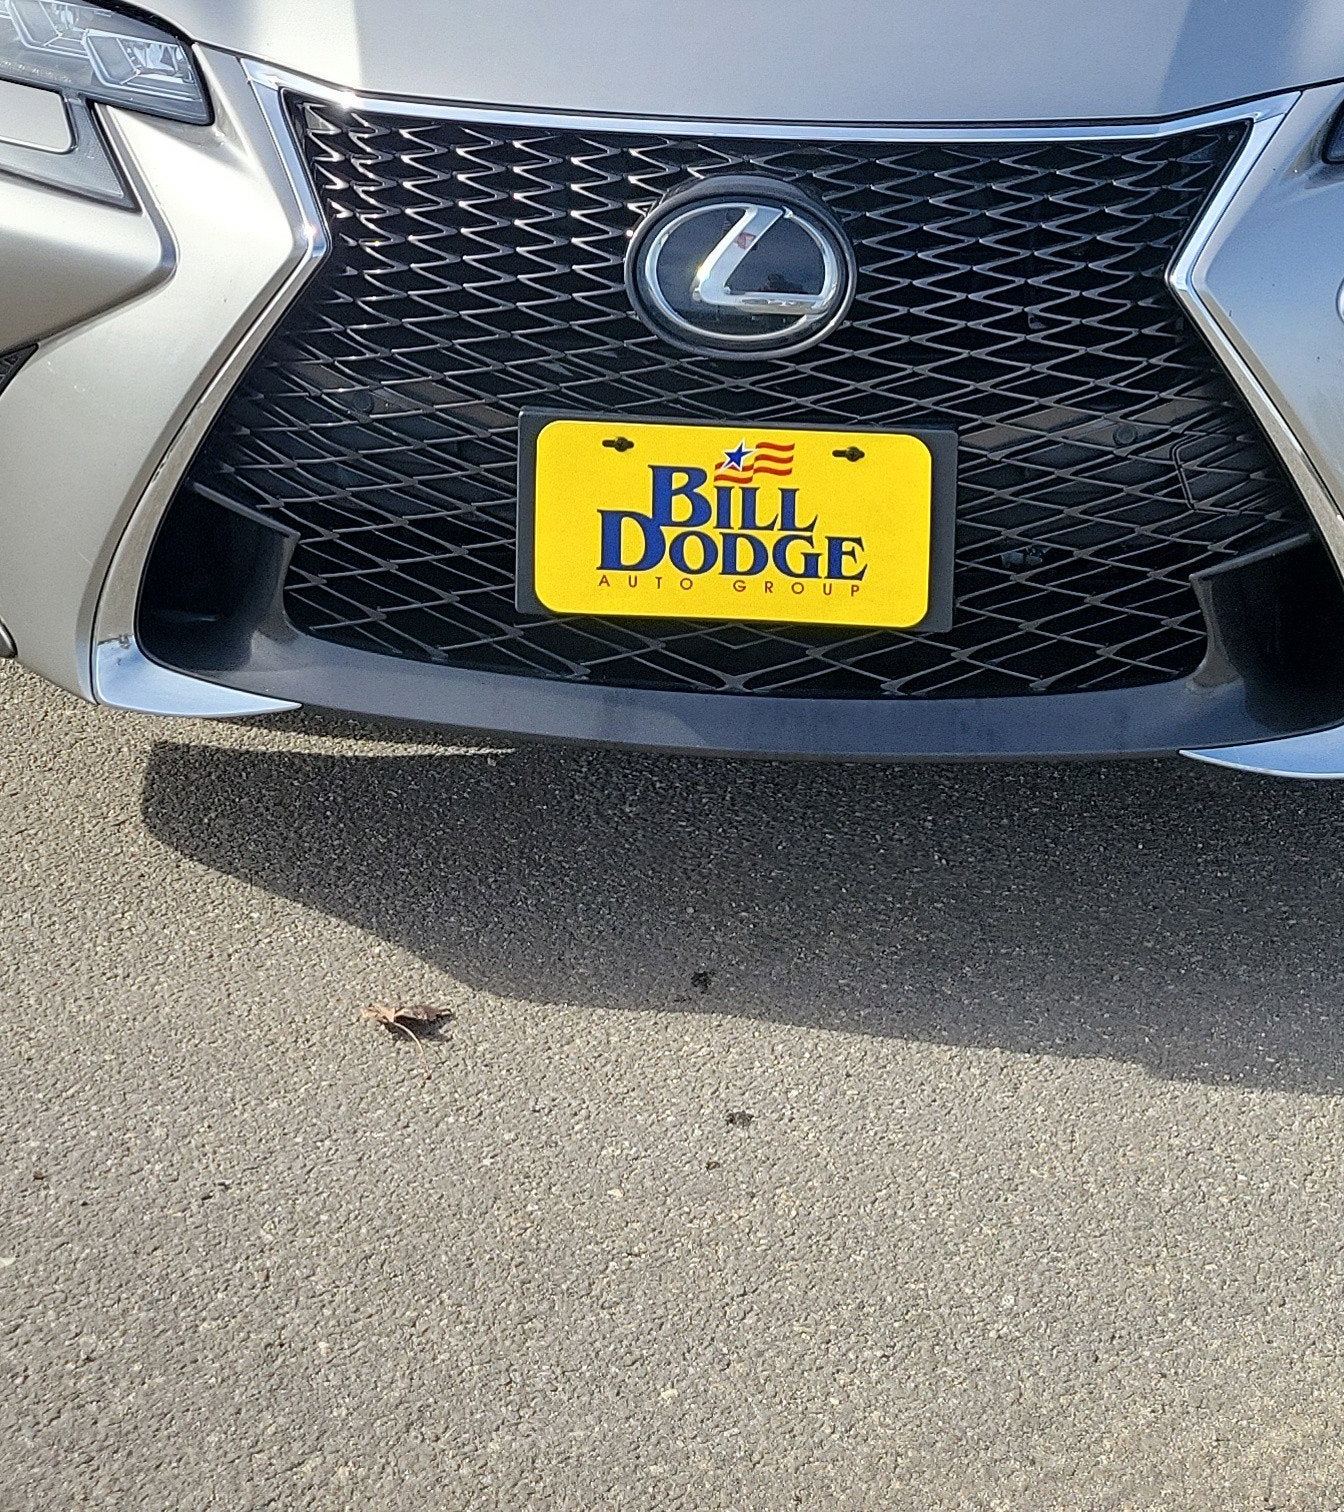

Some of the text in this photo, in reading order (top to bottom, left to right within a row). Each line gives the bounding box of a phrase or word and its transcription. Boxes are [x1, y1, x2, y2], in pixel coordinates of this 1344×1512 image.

[648, 464, 819, 532] BILL
[596, 509, 868, 581] DODGE
[598, 574, 861, 597] AUTO GROUP
